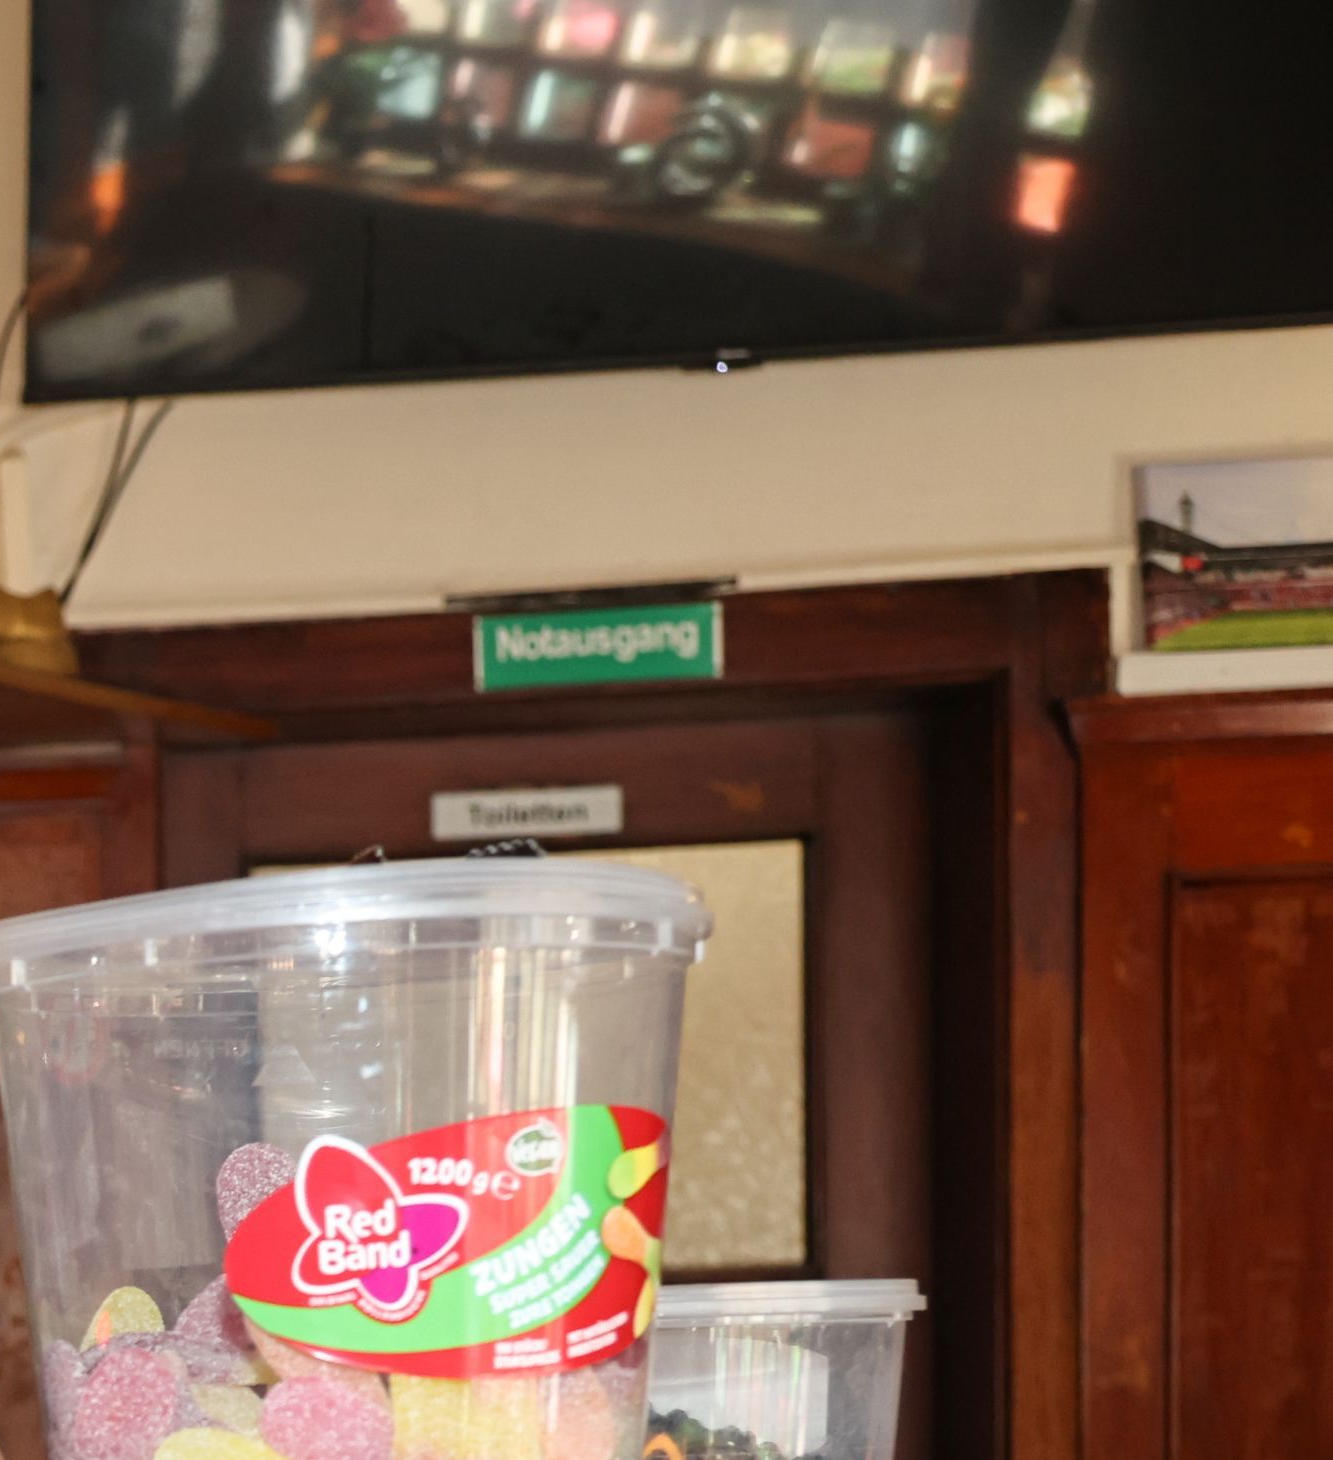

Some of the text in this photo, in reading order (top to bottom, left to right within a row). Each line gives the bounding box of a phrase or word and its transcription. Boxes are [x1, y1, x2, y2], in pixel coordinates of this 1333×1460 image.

[494, 620, 699, 662] Notausgang
[468, 803, 590, 826] Toiletten
[323, 1197, 397, 1244] Red
[316, 1228, 412, 1276] Band
[468, 1192, 592, 1298] ZUNGEN
